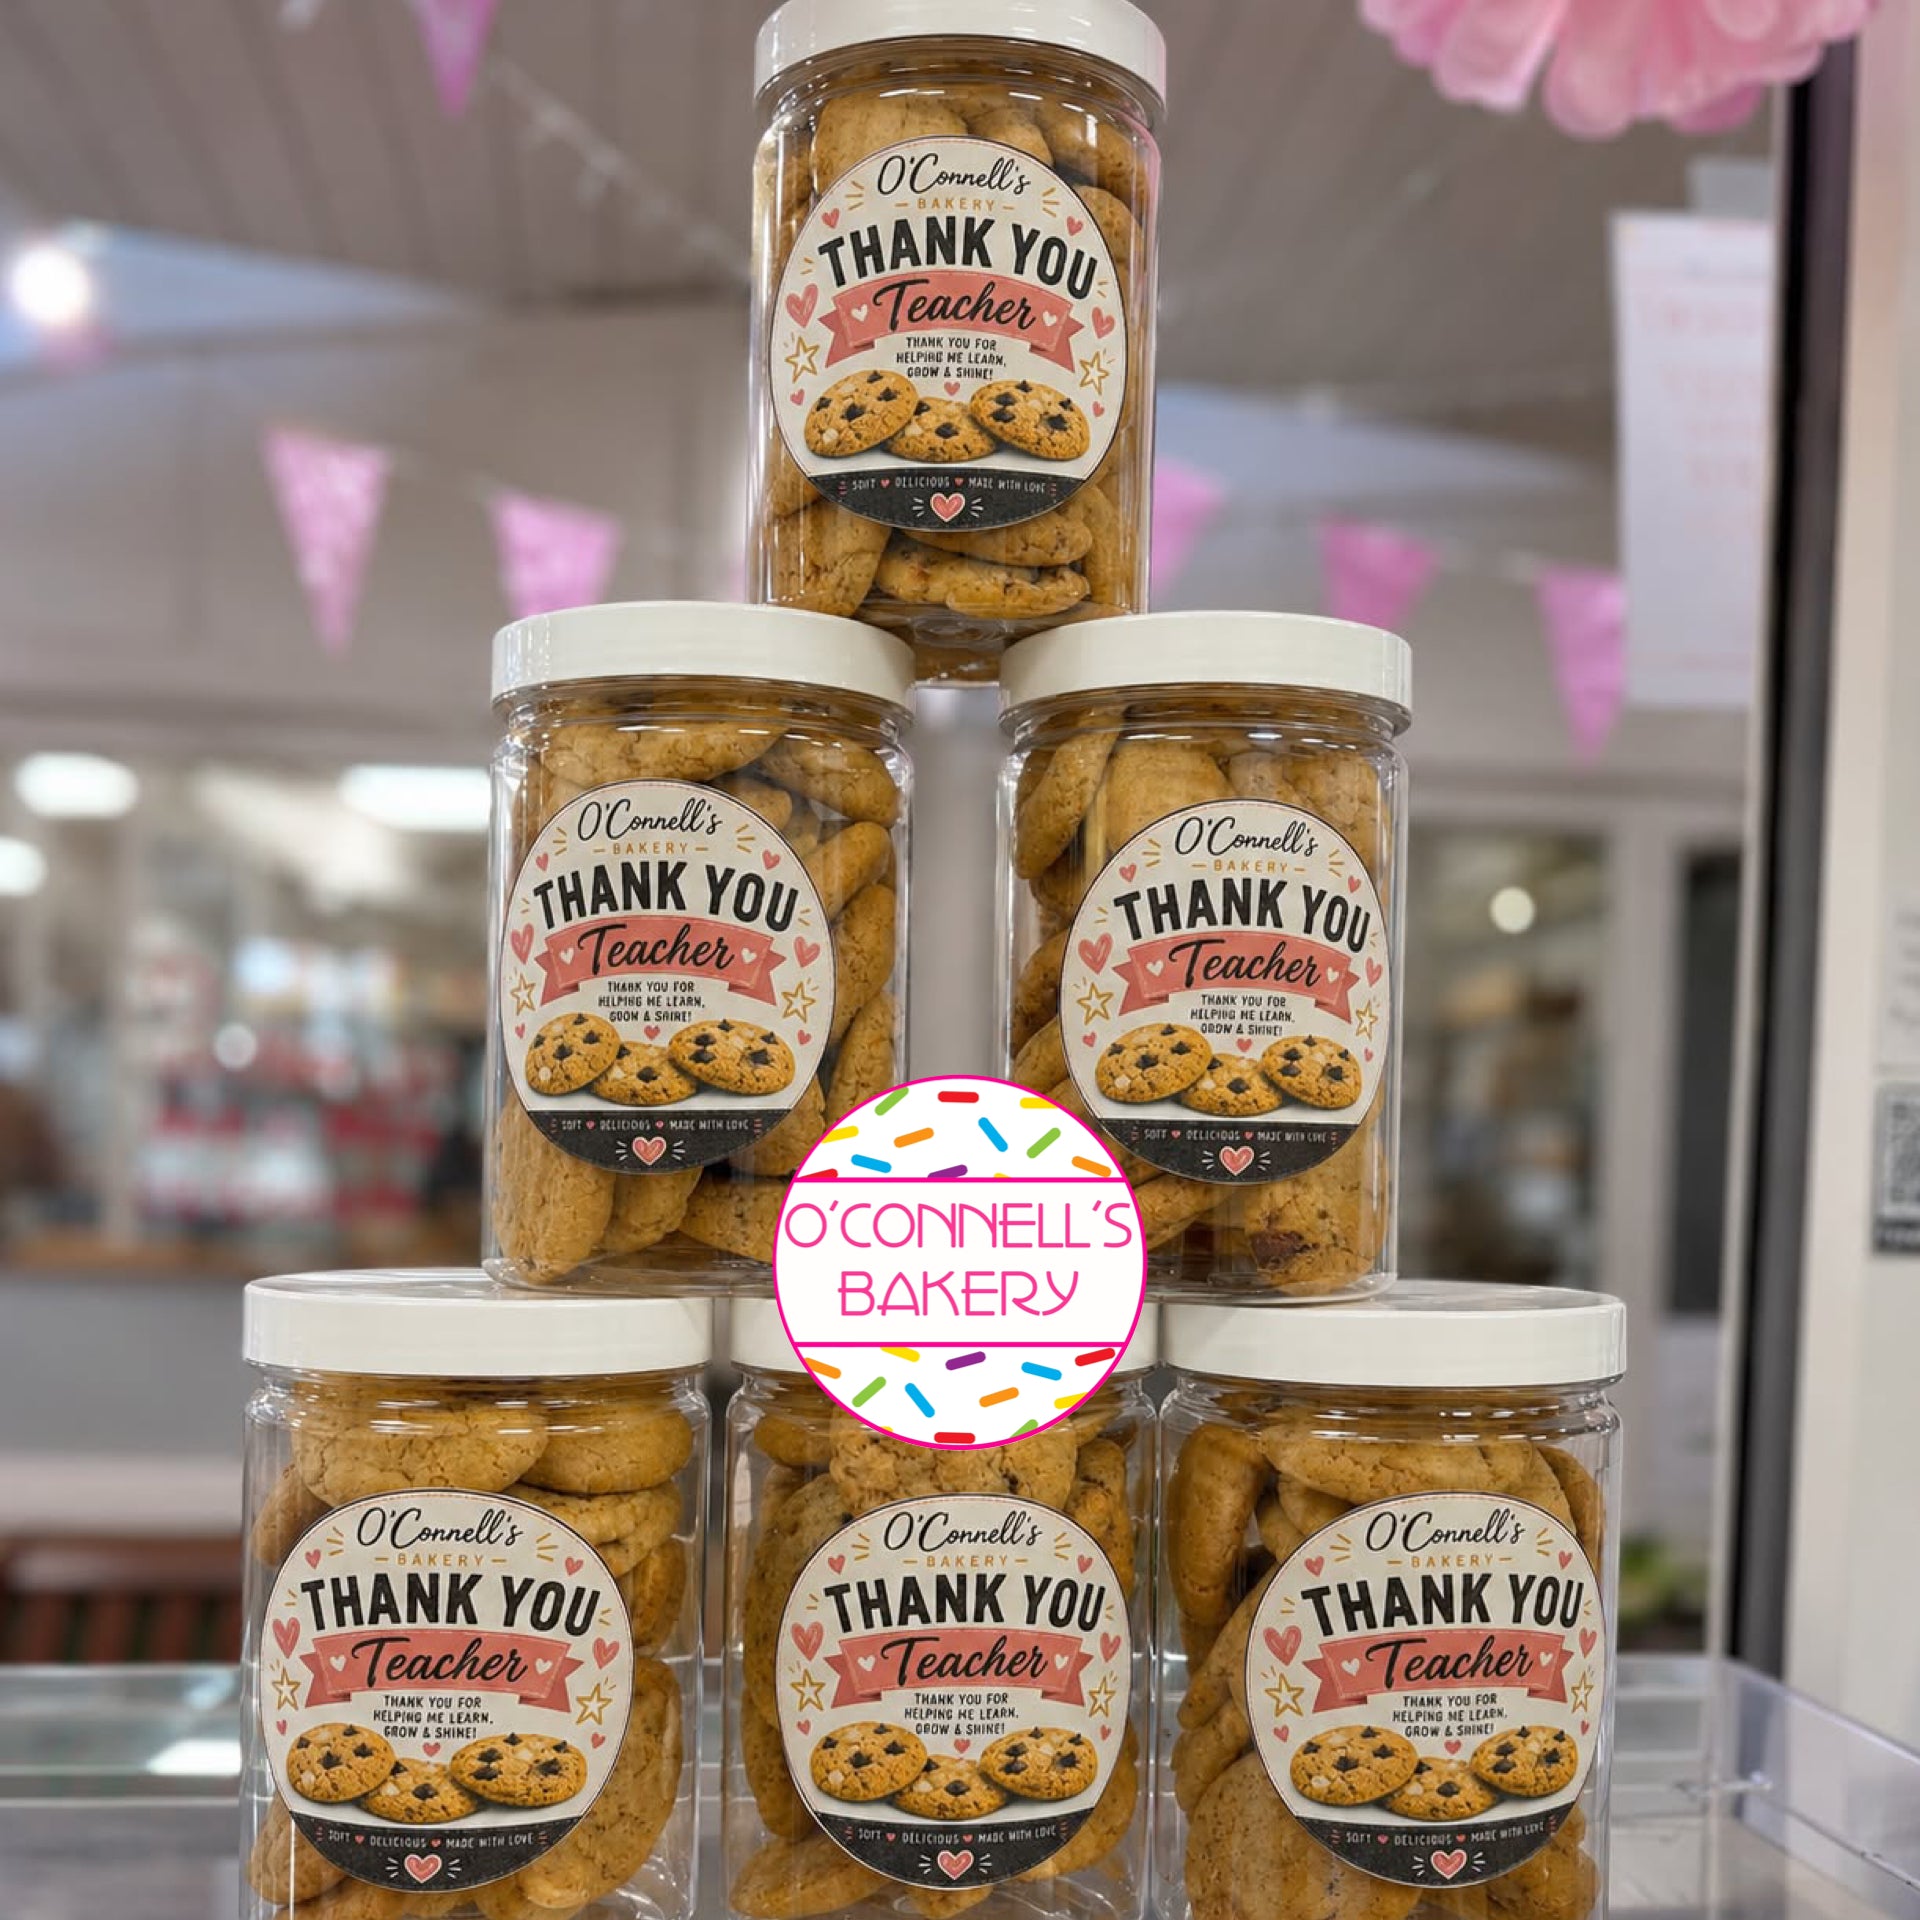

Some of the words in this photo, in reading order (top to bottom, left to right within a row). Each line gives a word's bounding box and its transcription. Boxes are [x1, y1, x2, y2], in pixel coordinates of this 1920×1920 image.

[877, 153, 1031, 194] O'Connell's
[917, 198, 996, 212] BAKERY
[818, 216, 995, 288] THANK
[1012, 224, 1098, 300] YOU
[873, 278, 1036, 331] Teacher
[578, 798, 723, 840] O'Connell's
[1175, 817, 1319, 857] O'Connell's
[613, 843, 688, 855] BAKERY
[1214, 860, 1288, 874] BAKERY
[534, 861, 687, 930] THANK
[705, 864, 798, 932] YOU
[1113, 878, 1287, 940] THANK
[1302, 885, 1370, 953] YOU
[578, 924, 734, 976] Teacher
[1168, 939, 1321, 988] Teacher
[357, 1507, 523, 1549] O'Connell's
[884, 1511, 1042, 1552] O'Connell's
[1366, 1509, 1526, 1552] O'Connell's
[398, 1553, 485, 1566] BAKERY
[926, 1555, 1008, 1568] BAKERY
[1411, 1554, 1494, 1568] BAKERY
[301, 1573, 483, 1631] THANK
[502, 1576, 601, 1636] YOU
[824, 1574, 1006, 1633] THANK
[1025, 1575, 1105, 1632] YOU
[1301, 1573, 1492, 1637] THANK
[1509, 1574, 1584, 1628] YOU
[352, 1637, 528, 1688] Teacher
[881, 1635, 1048, 1686] Teacher
[1365, 1635, 1533, 1689] Teacher
[427, 1711, 444, 1723] ME
[429, 1697, 452, 1708] YOU
[458, 1696, 481, 1708] FOR
[959, 1693, 981, 1705] YOU
[987, 1693, 1008, 1705] FOR
[1448, 1695, 1471, 1707] YOU
